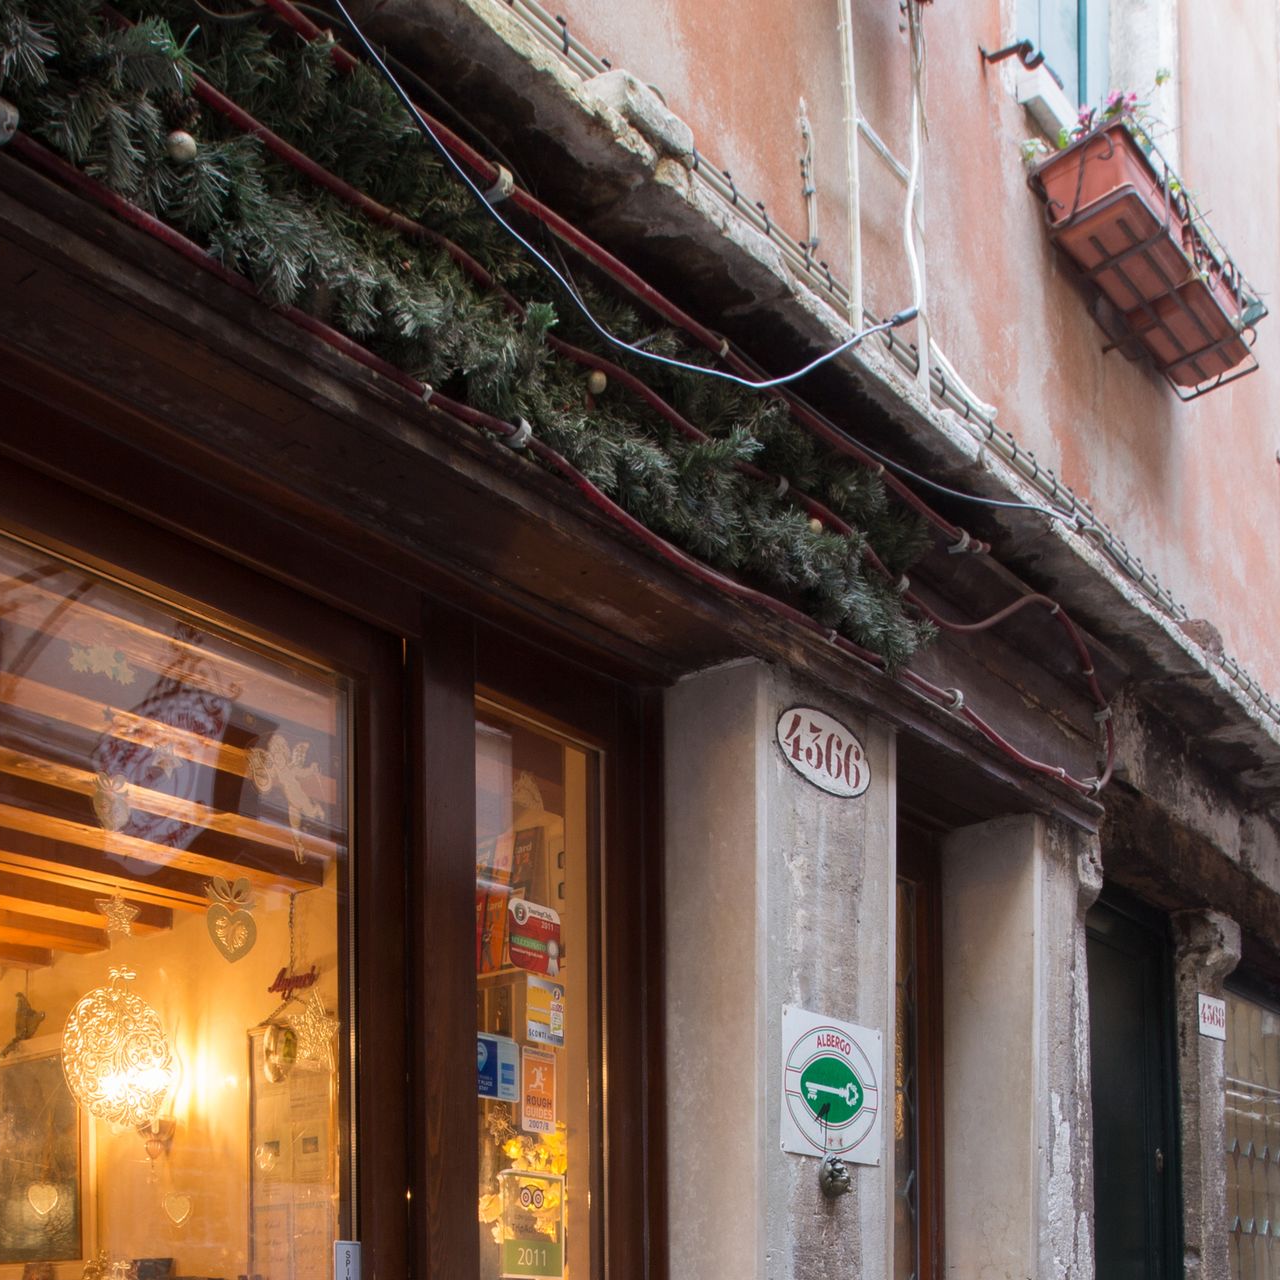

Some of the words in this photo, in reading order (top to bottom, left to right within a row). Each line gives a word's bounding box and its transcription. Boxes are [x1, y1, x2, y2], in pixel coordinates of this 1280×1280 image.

[783, 713, 861, 789] 4366
[528, 1028, 547, 1039] SCONTI
[817, 1033, 852, 1056] ALBERGO
[526, 1094, 552, 1107] ROUGH
[526, 1106, 553, 1120] GUIDES
[518, 1247, 547, 1266] 2011
